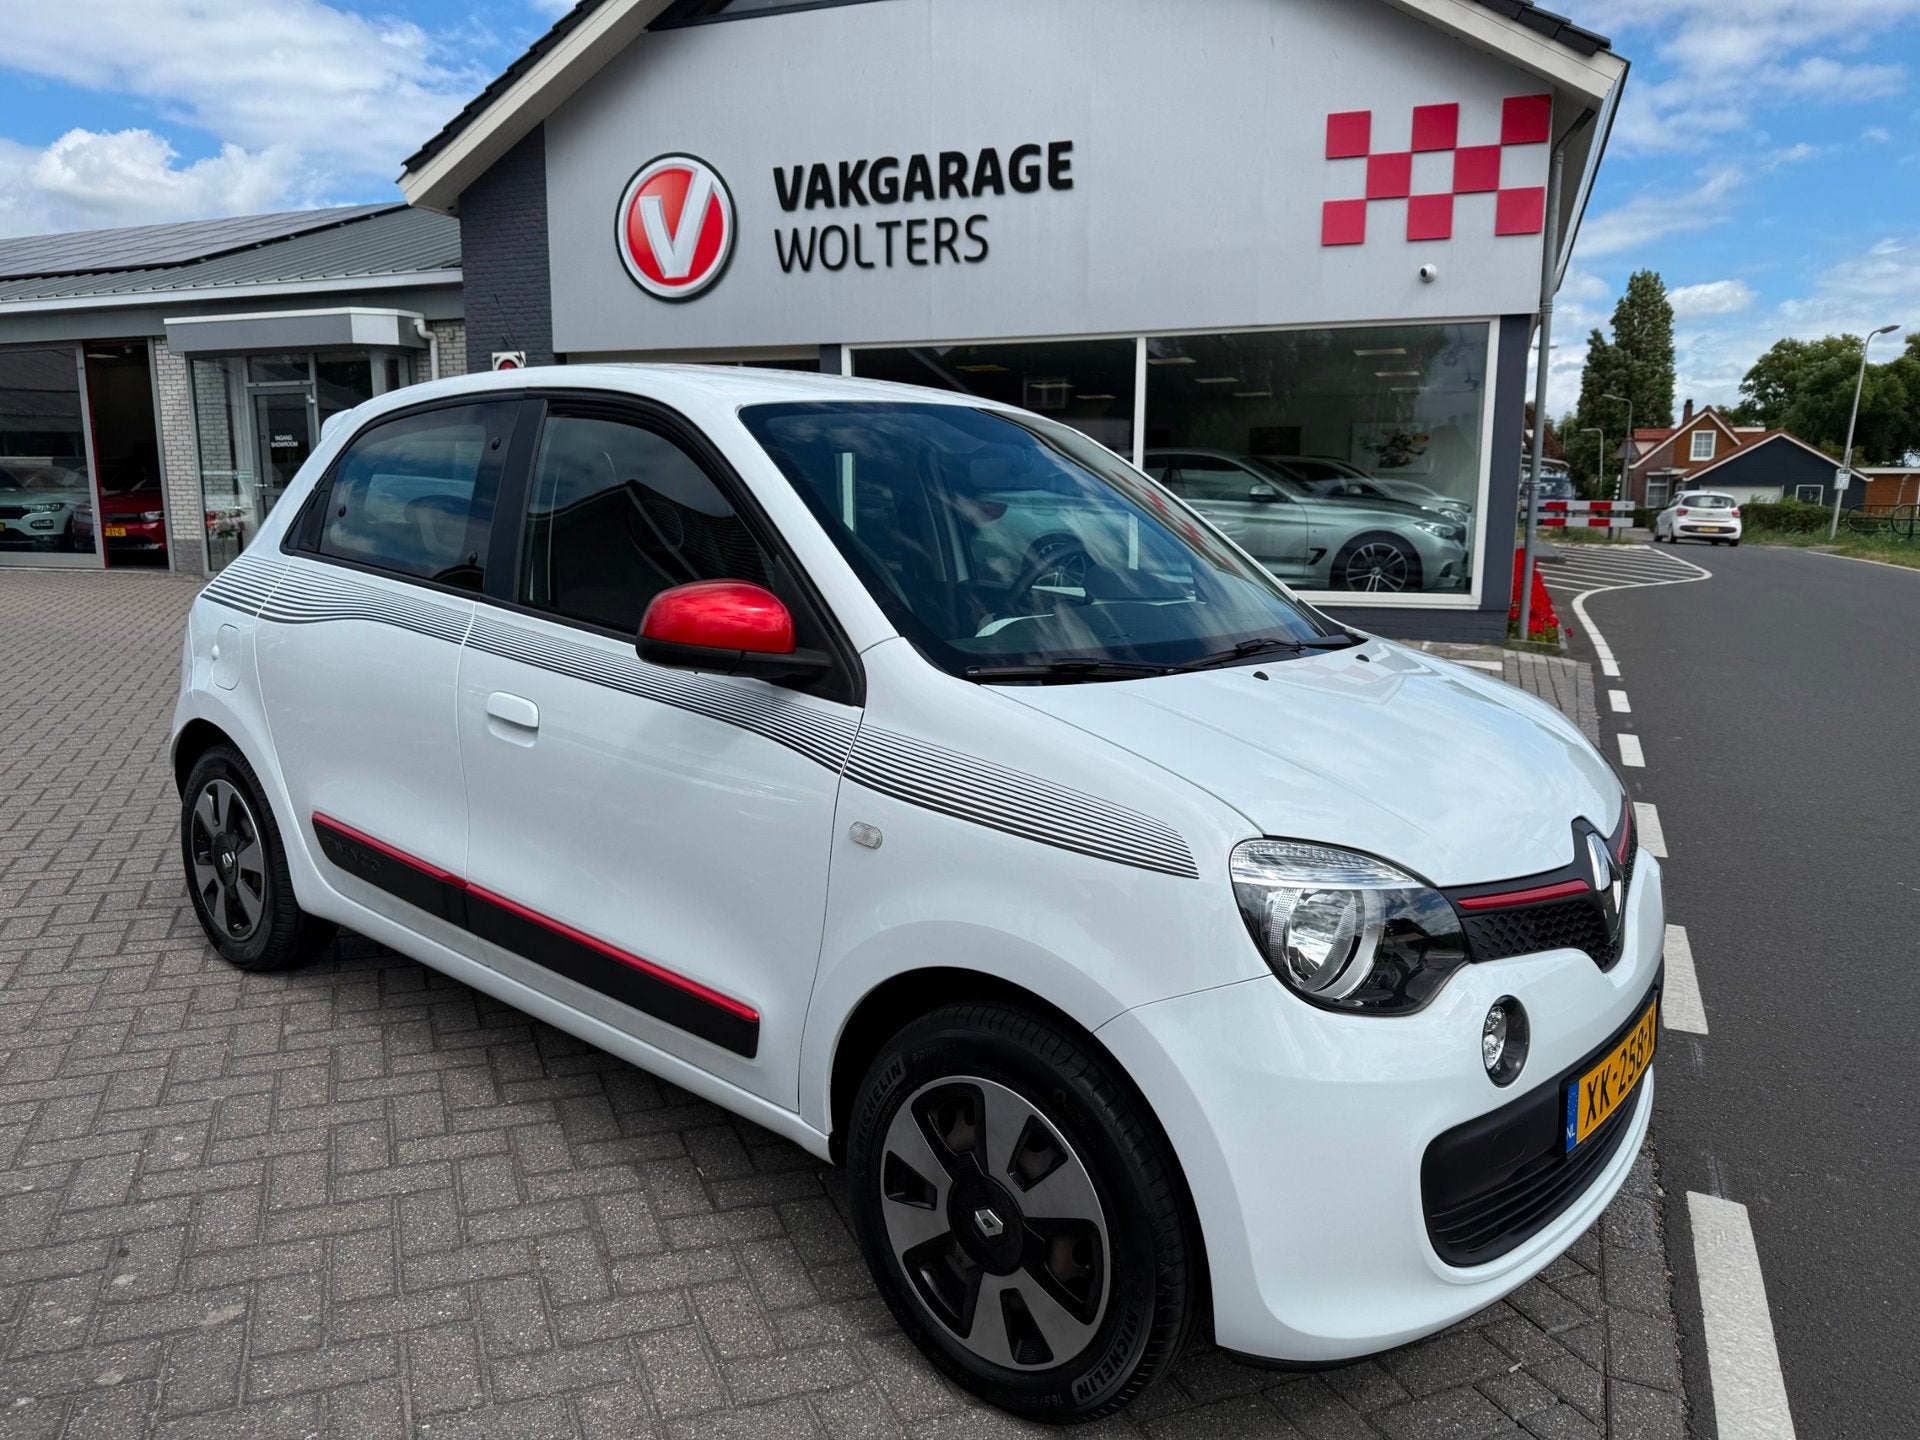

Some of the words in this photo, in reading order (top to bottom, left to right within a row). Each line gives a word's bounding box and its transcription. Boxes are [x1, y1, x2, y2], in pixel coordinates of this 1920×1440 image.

[772, 140, 1074, 213] VAKGARAGE
[773, 213, 990, 274] WOLTERS
[856, 1061, 903, 1153] MICHELIN
[1565, 1122, 1576, 1141] NL
[1076, 1307, 1140, 1400] MICHELIN
